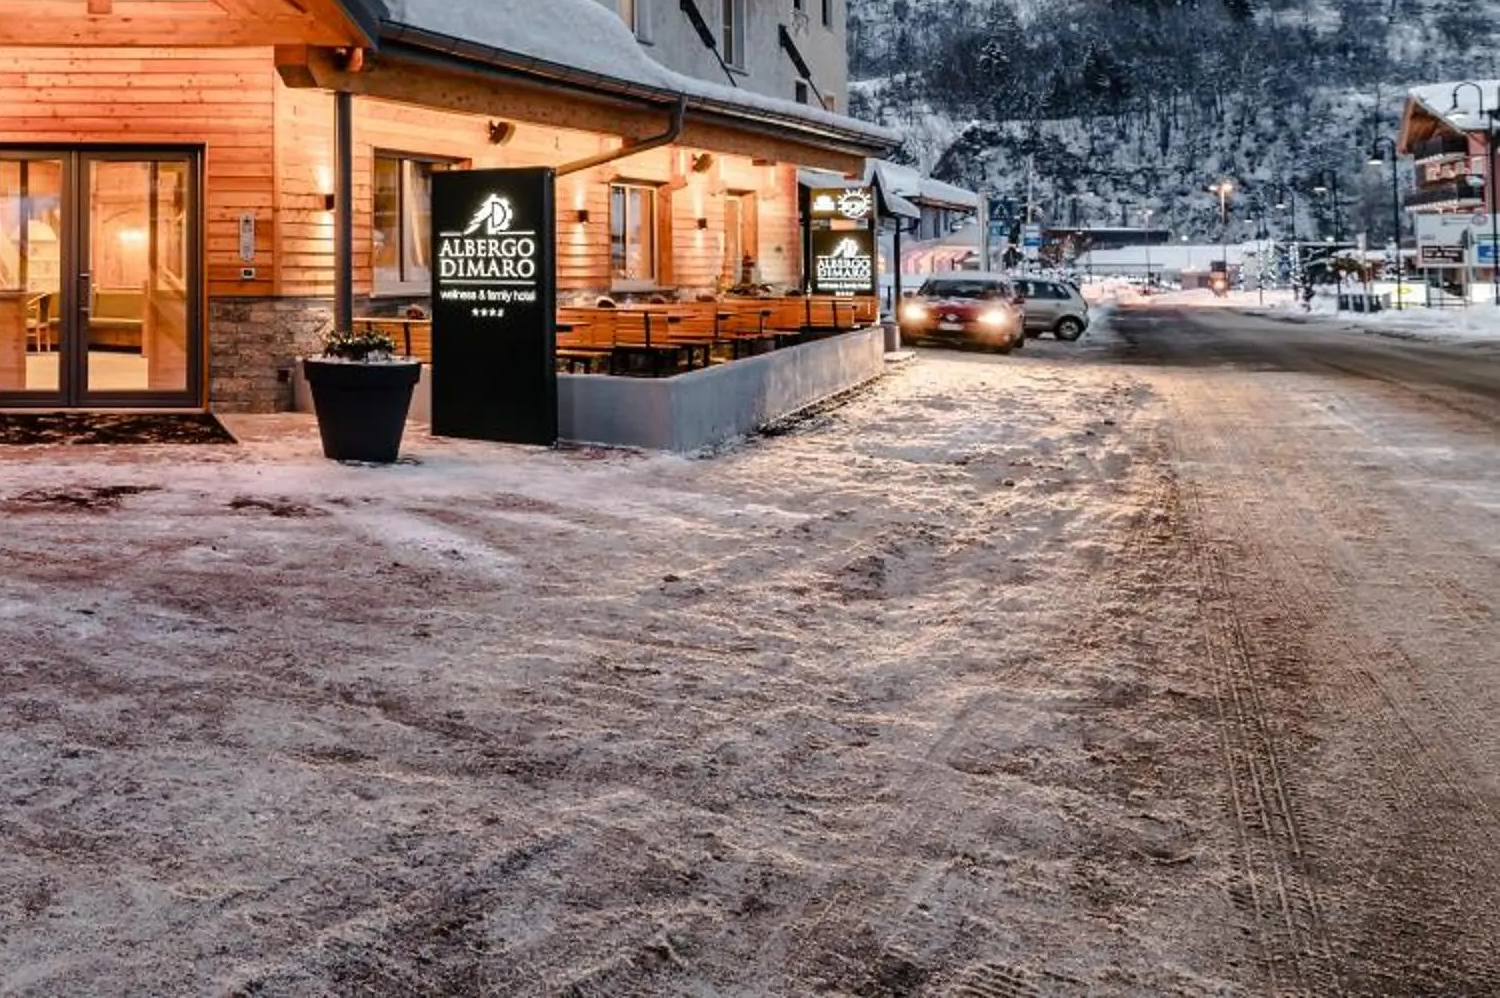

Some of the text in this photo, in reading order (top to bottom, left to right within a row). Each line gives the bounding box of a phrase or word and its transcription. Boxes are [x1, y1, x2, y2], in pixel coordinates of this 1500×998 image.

[439, 238, 535, 257] ALBERGO
[440, 258, 535, 278] DIMARO
[479, 289, 486, 301] &
[487, 289, 512, 303] family
[513, 289, 536, 301] hotel
